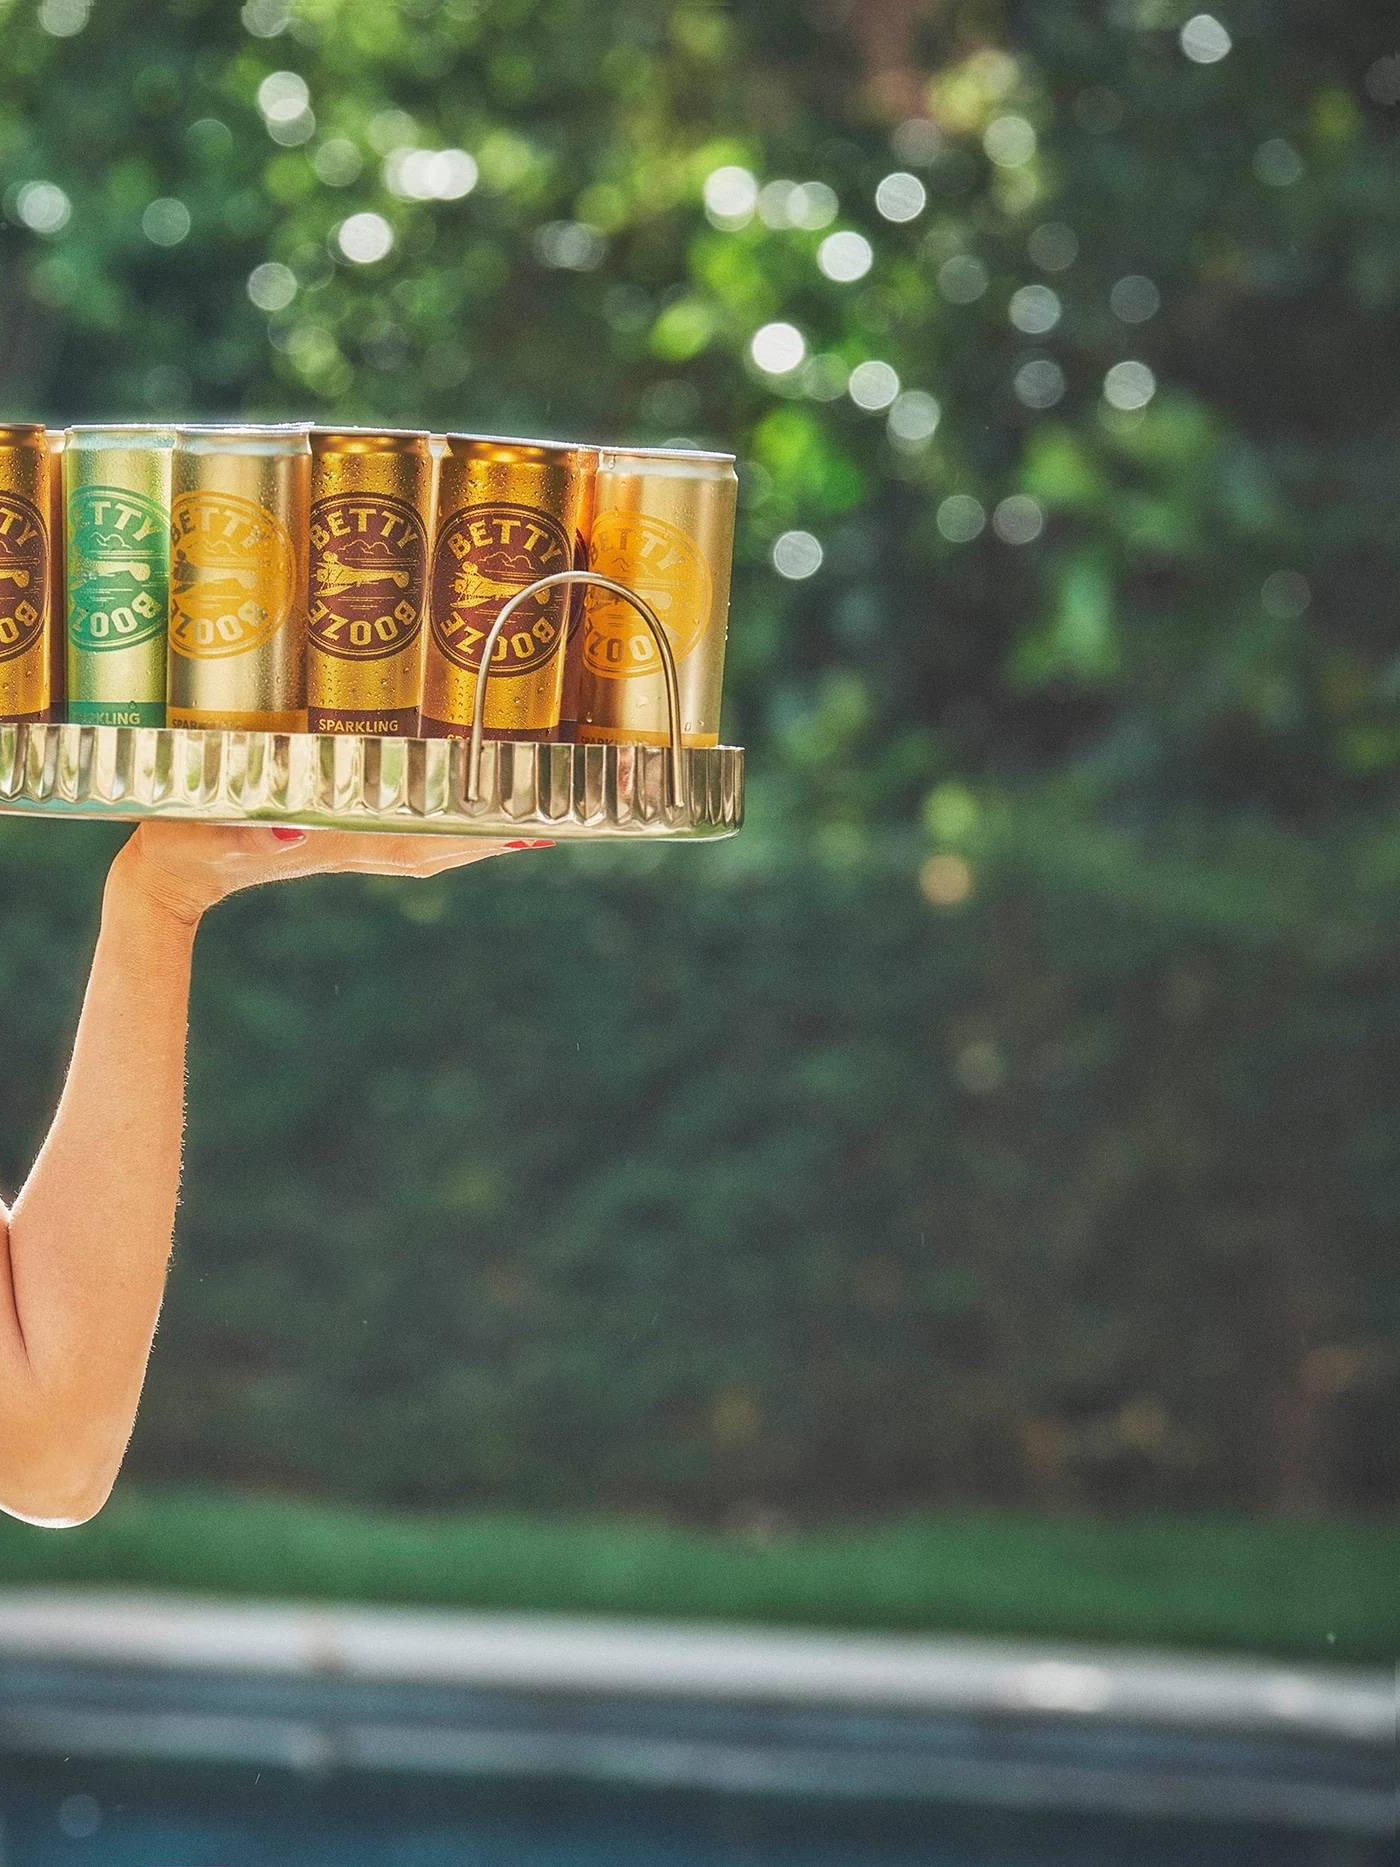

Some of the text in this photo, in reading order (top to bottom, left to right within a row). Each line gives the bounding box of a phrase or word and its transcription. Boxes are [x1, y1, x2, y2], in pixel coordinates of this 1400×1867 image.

[310, 508, 418, 550] BETTY
[447, 518, 563, 564] BETTY
[308, 600, 417, 646] BOOZE
[440, 611, 556, 661] BOOZE
[318, 718, 399, 734] SPARKLING
